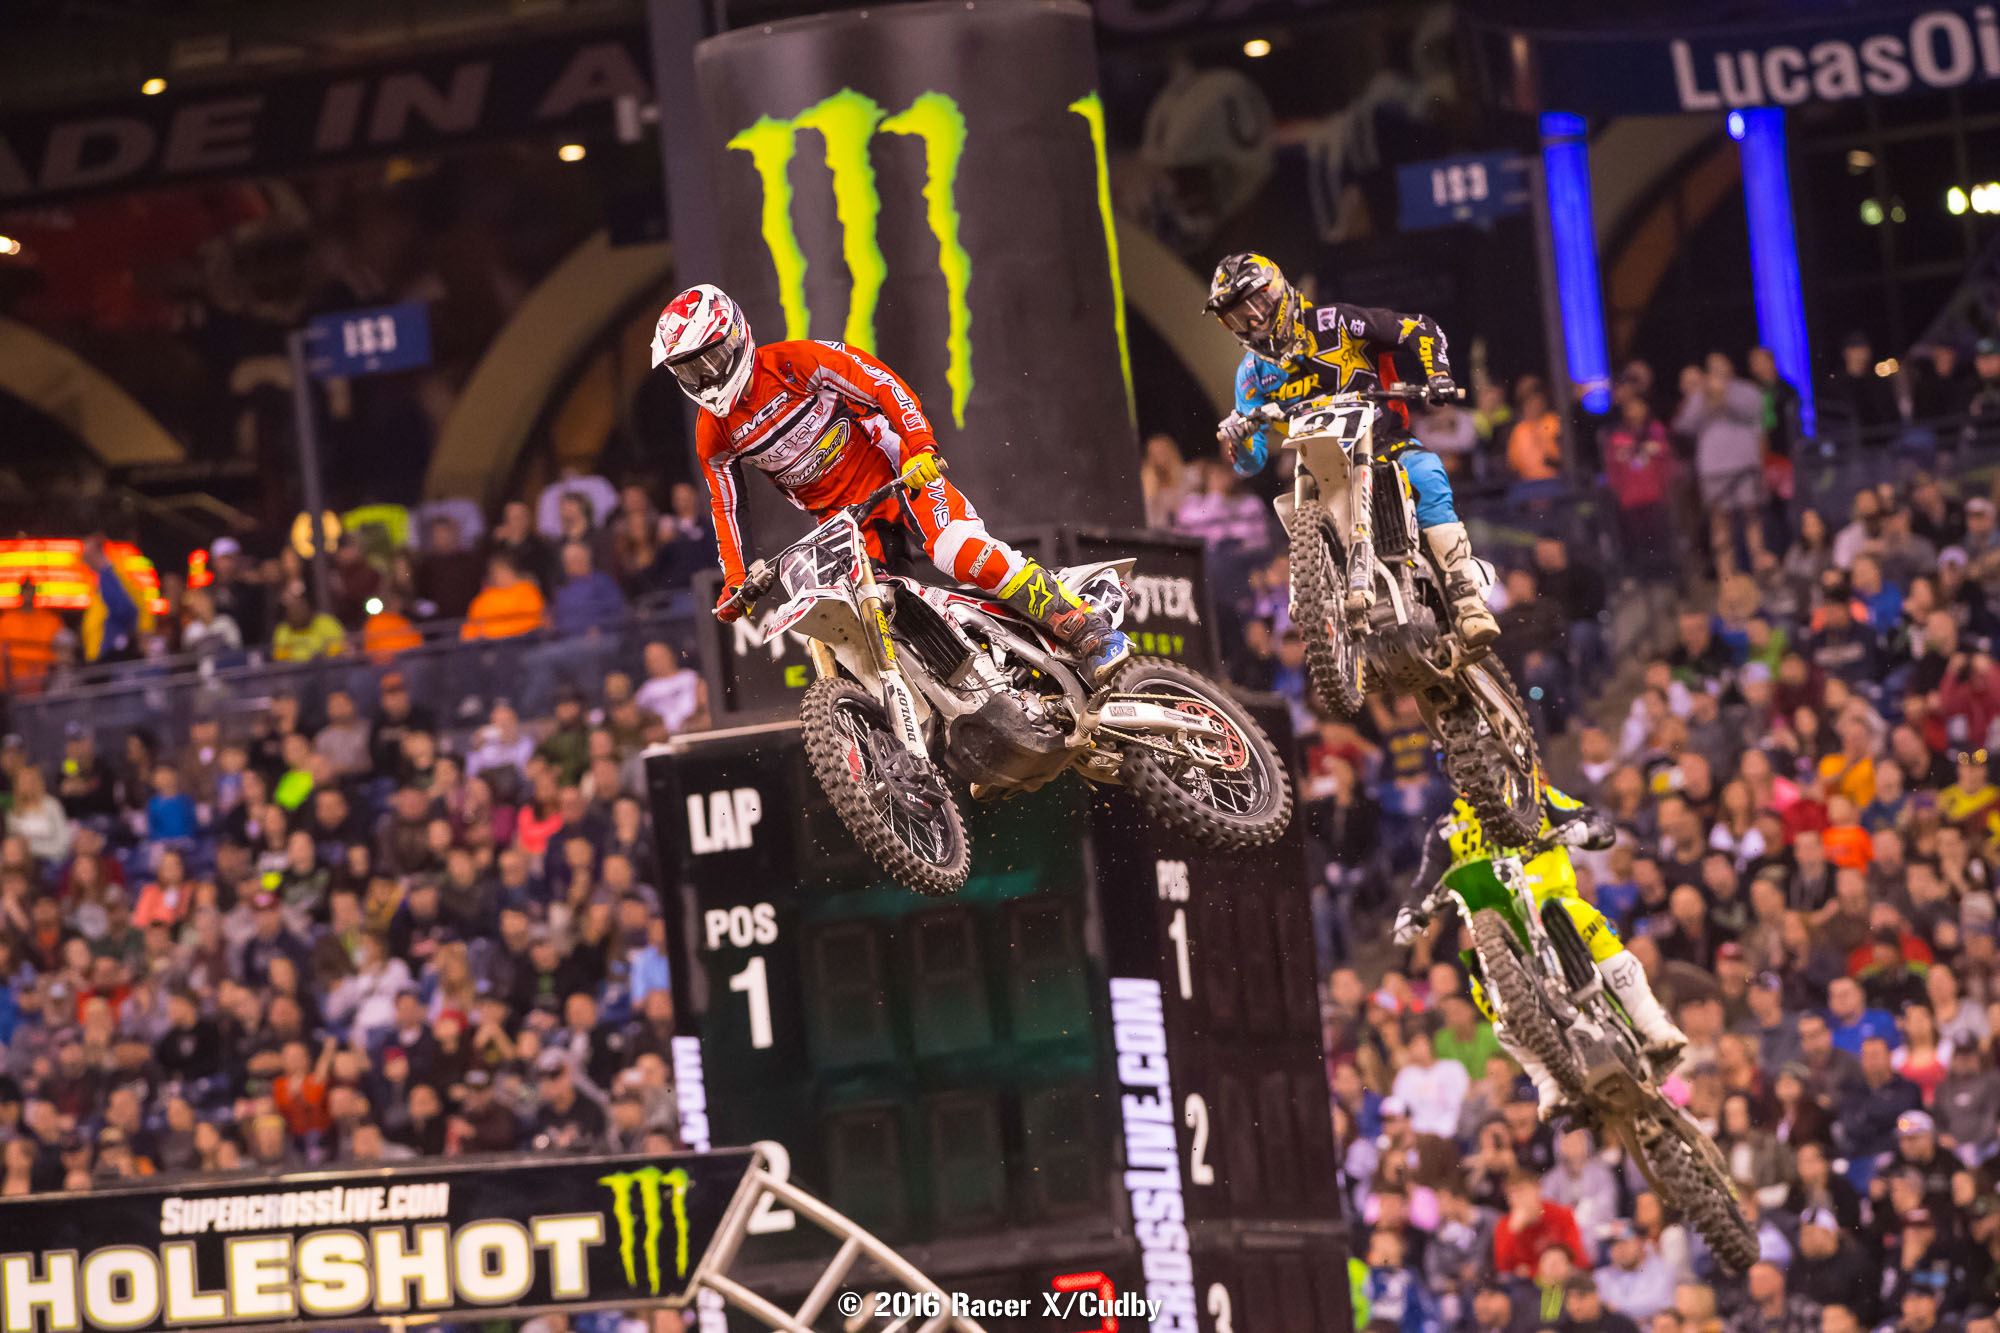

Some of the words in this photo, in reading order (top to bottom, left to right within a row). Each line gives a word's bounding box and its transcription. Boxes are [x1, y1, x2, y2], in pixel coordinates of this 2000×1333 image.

[896, 687, 917, 743] DUNLOP
[686, 787, 762, 855] LAP
[704, 901, 778, 950] POS
[1168, 908, 1193, 1000] 1
[729, 955, 773, 1049] 1
[1185, 1093, 1215, 1186] 2
[0, 1211, 606, 1333] HOLESHOT
